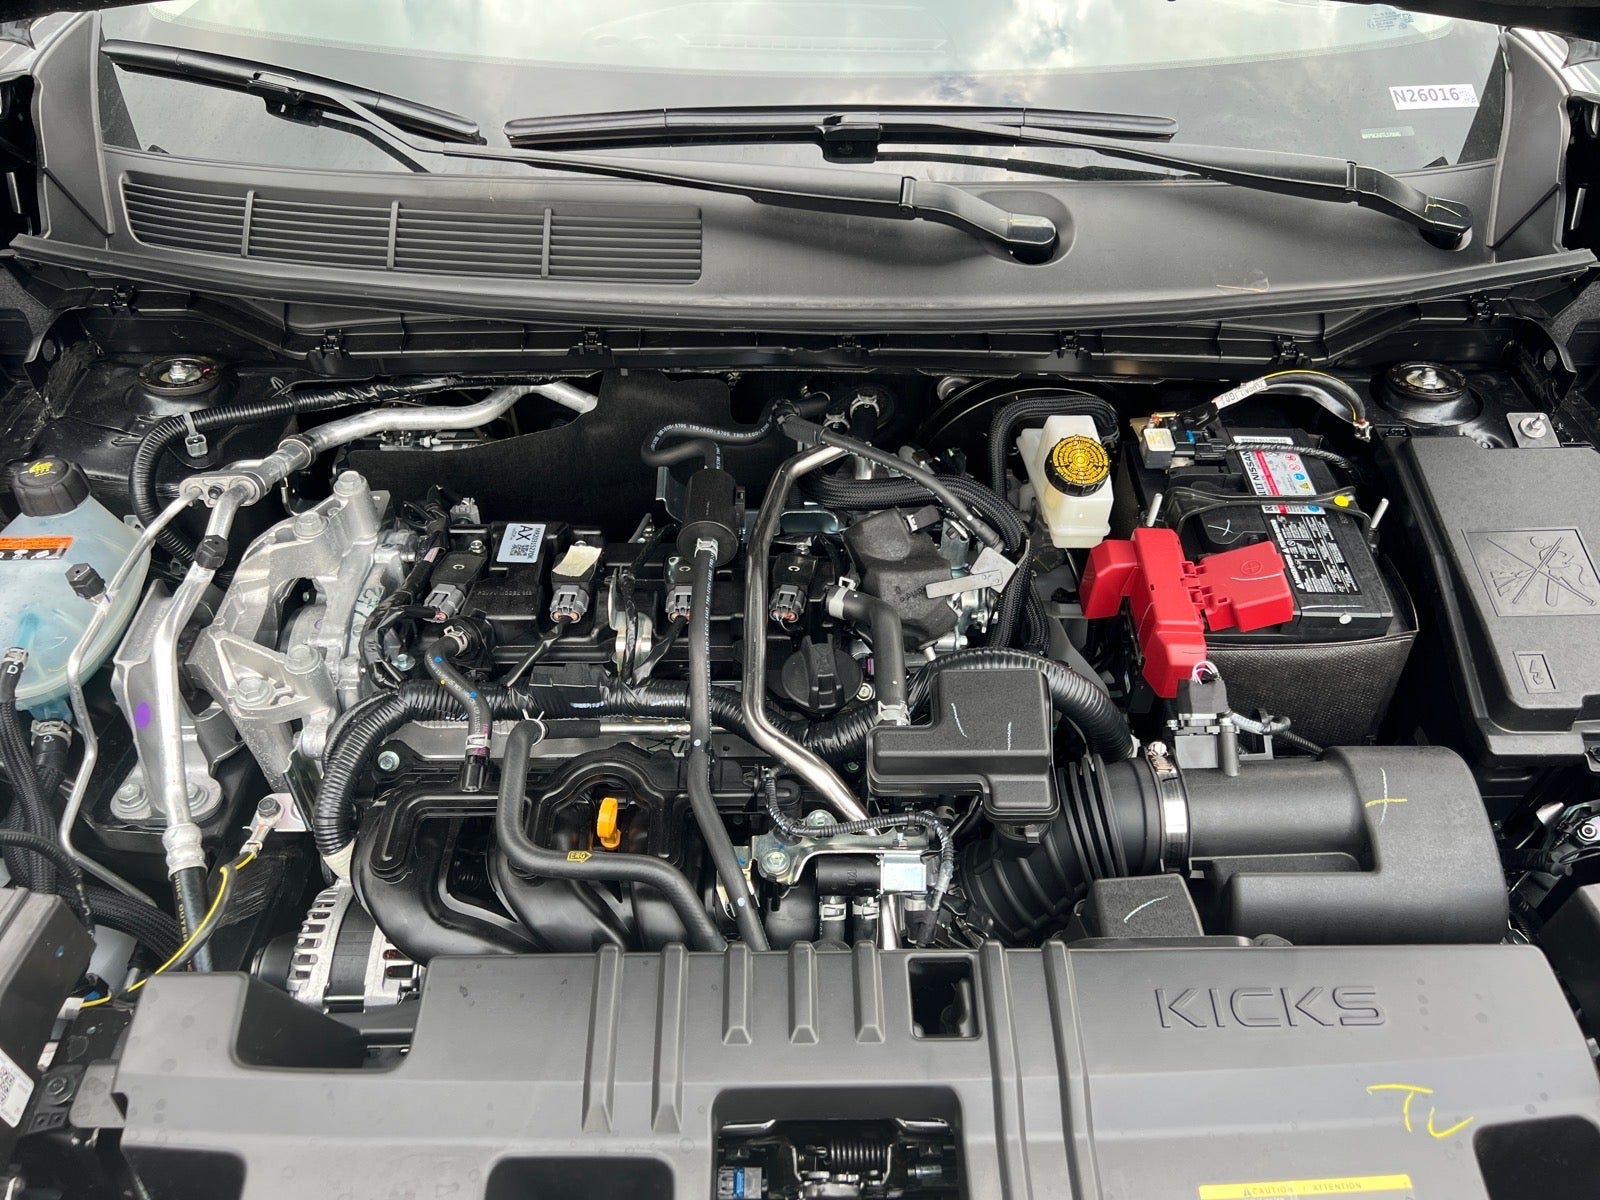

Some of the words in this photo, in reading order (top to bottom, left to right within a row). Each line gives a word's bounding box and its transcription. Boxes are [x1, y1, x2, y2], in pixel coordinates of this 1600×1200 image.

[1393, 88, 1460, 103] N26016
[516, 525, 533, 540] AX
[1154, 986, 1386, 1028] KICKS
[1252, 1185, 1294, 1195] CAUTION
[1313, 1181, 1362, 1192] ATTENTION
